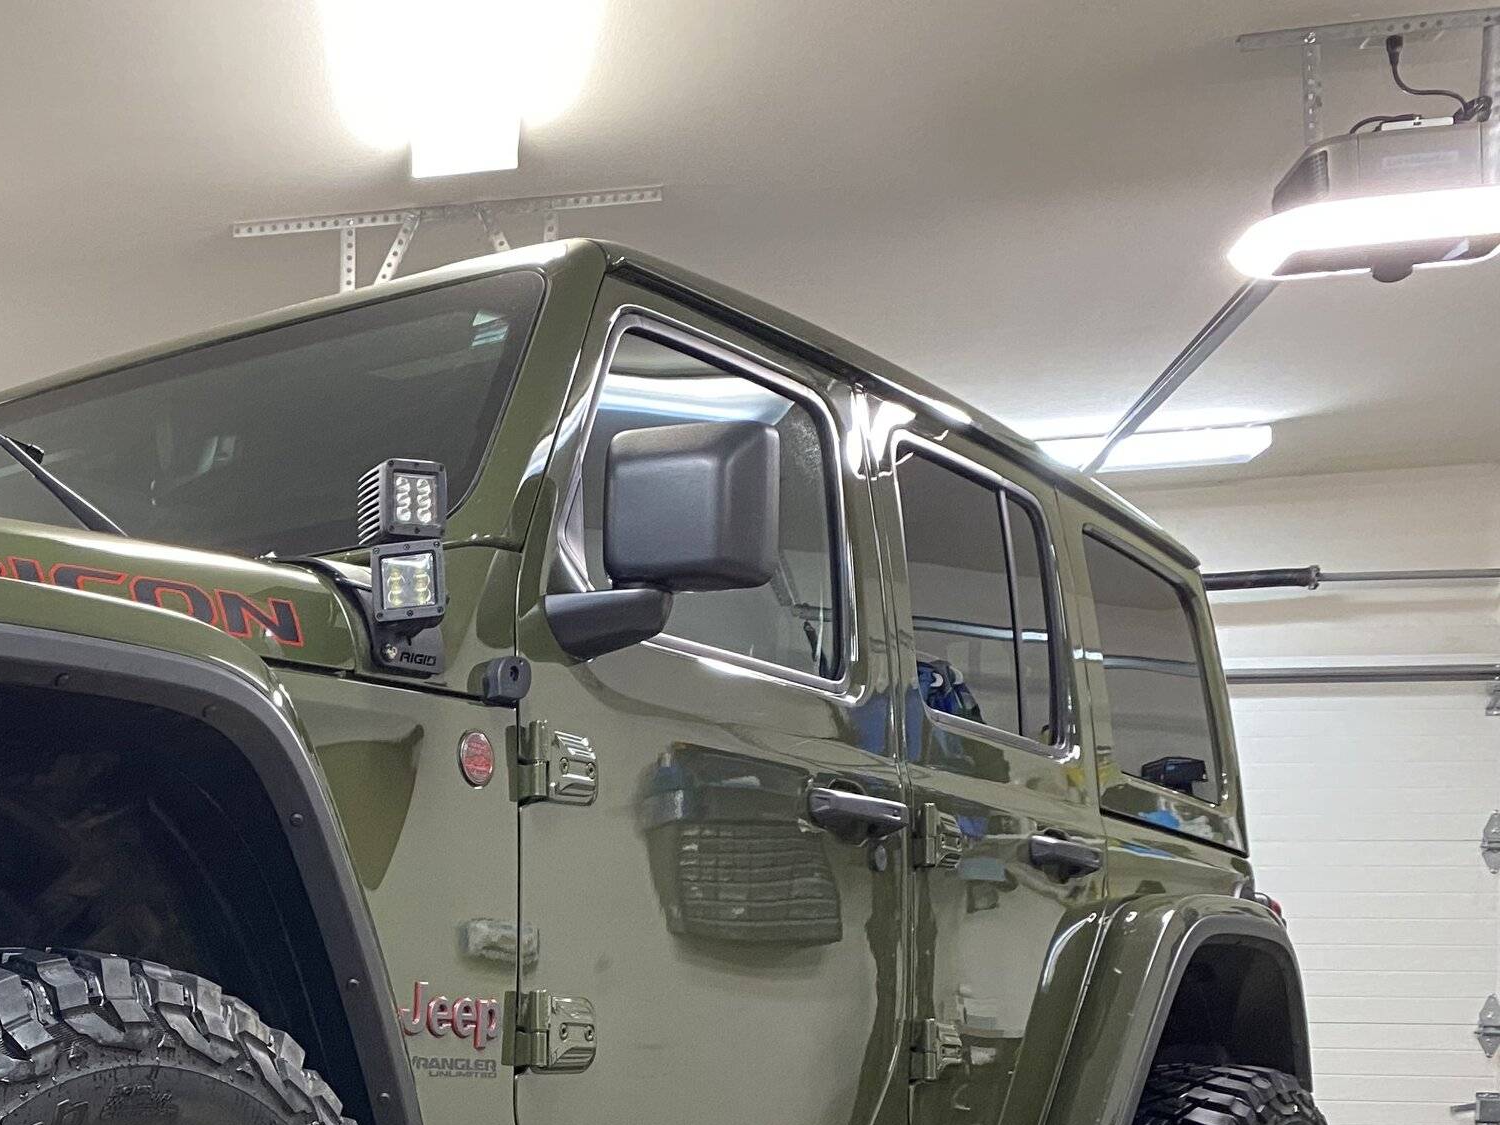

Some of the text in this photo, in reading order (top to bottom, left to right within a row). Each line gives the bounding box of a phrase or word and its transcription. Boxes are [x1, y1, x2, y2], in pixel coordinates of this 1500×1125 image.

[400, 651, 437, 666] RIGID
[398, 981, 501, 1050] Jeep
[429, 1071, 497, 1079] UNLIMITED
